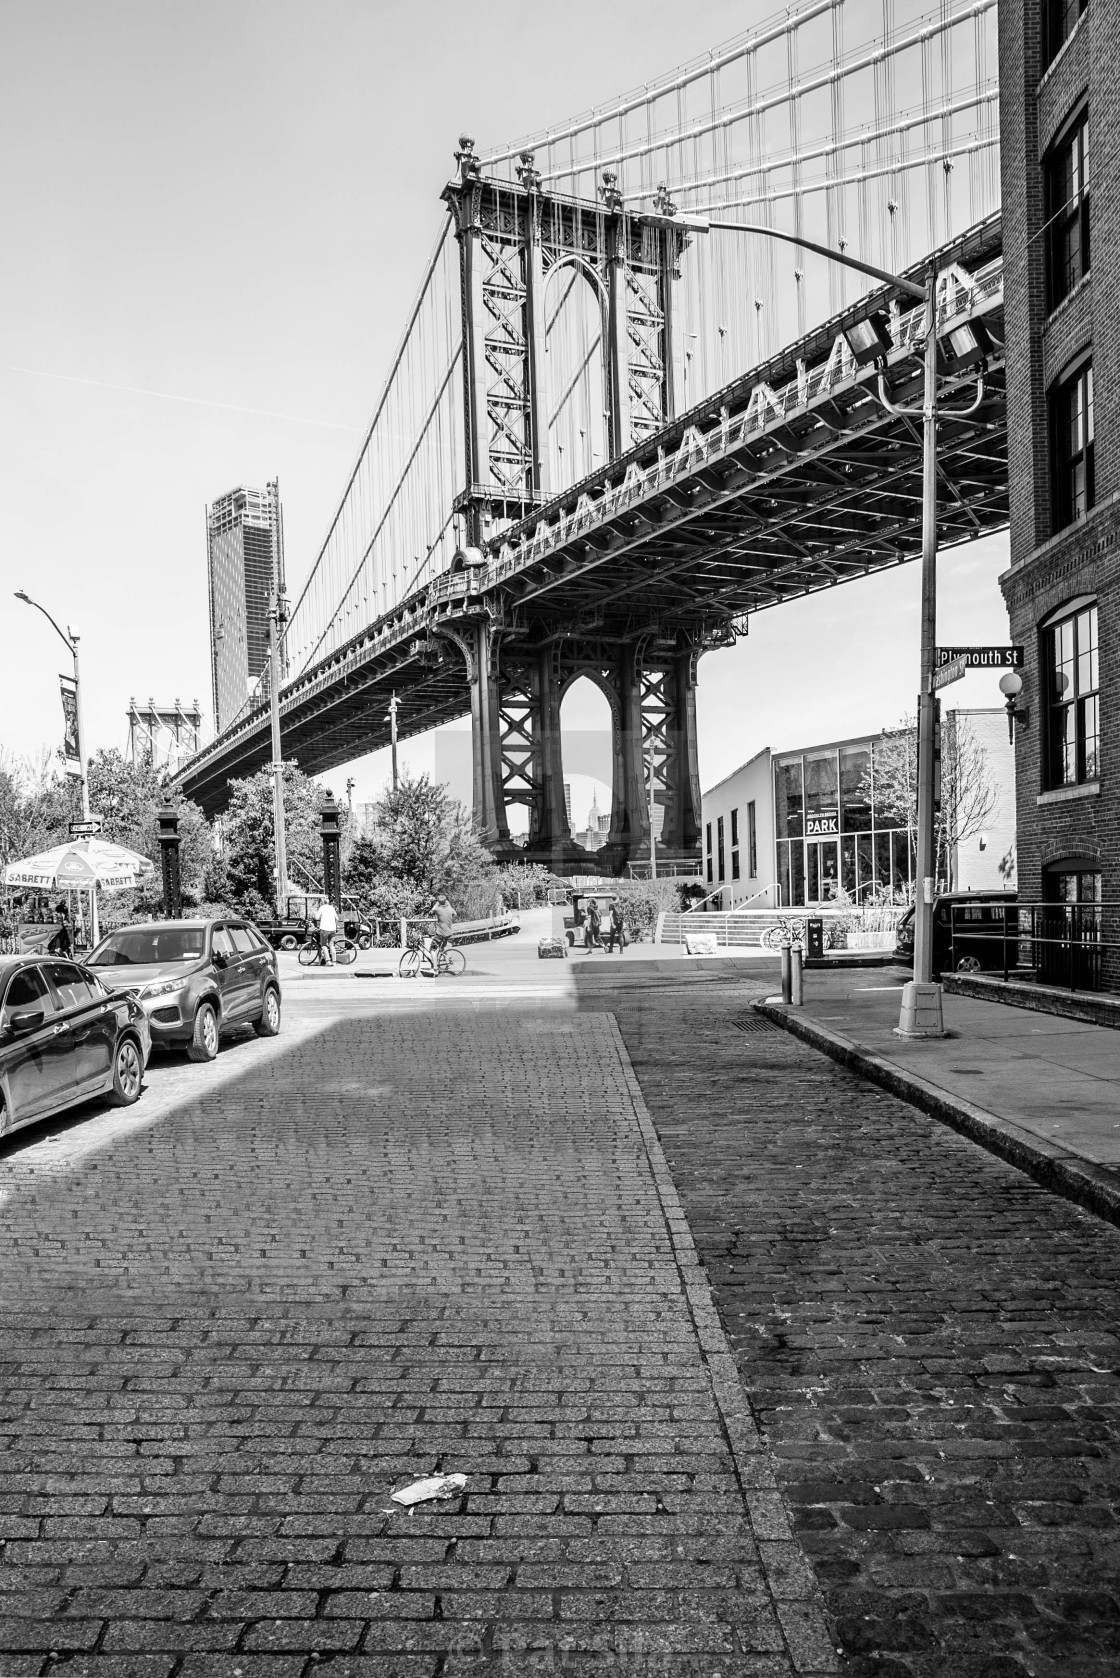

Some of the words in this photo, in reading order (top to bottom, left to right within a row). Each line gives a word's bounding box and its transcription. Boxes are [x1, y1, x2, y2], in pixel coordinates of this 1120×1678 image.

[1005, 650, 1018, 665] St
[934, 665, 958, 688] ashington
[807, 818, 837, 834] PARK
[8, 873, 51, 884] SABRETT
[101, 876, 132, 886] SABRETT
